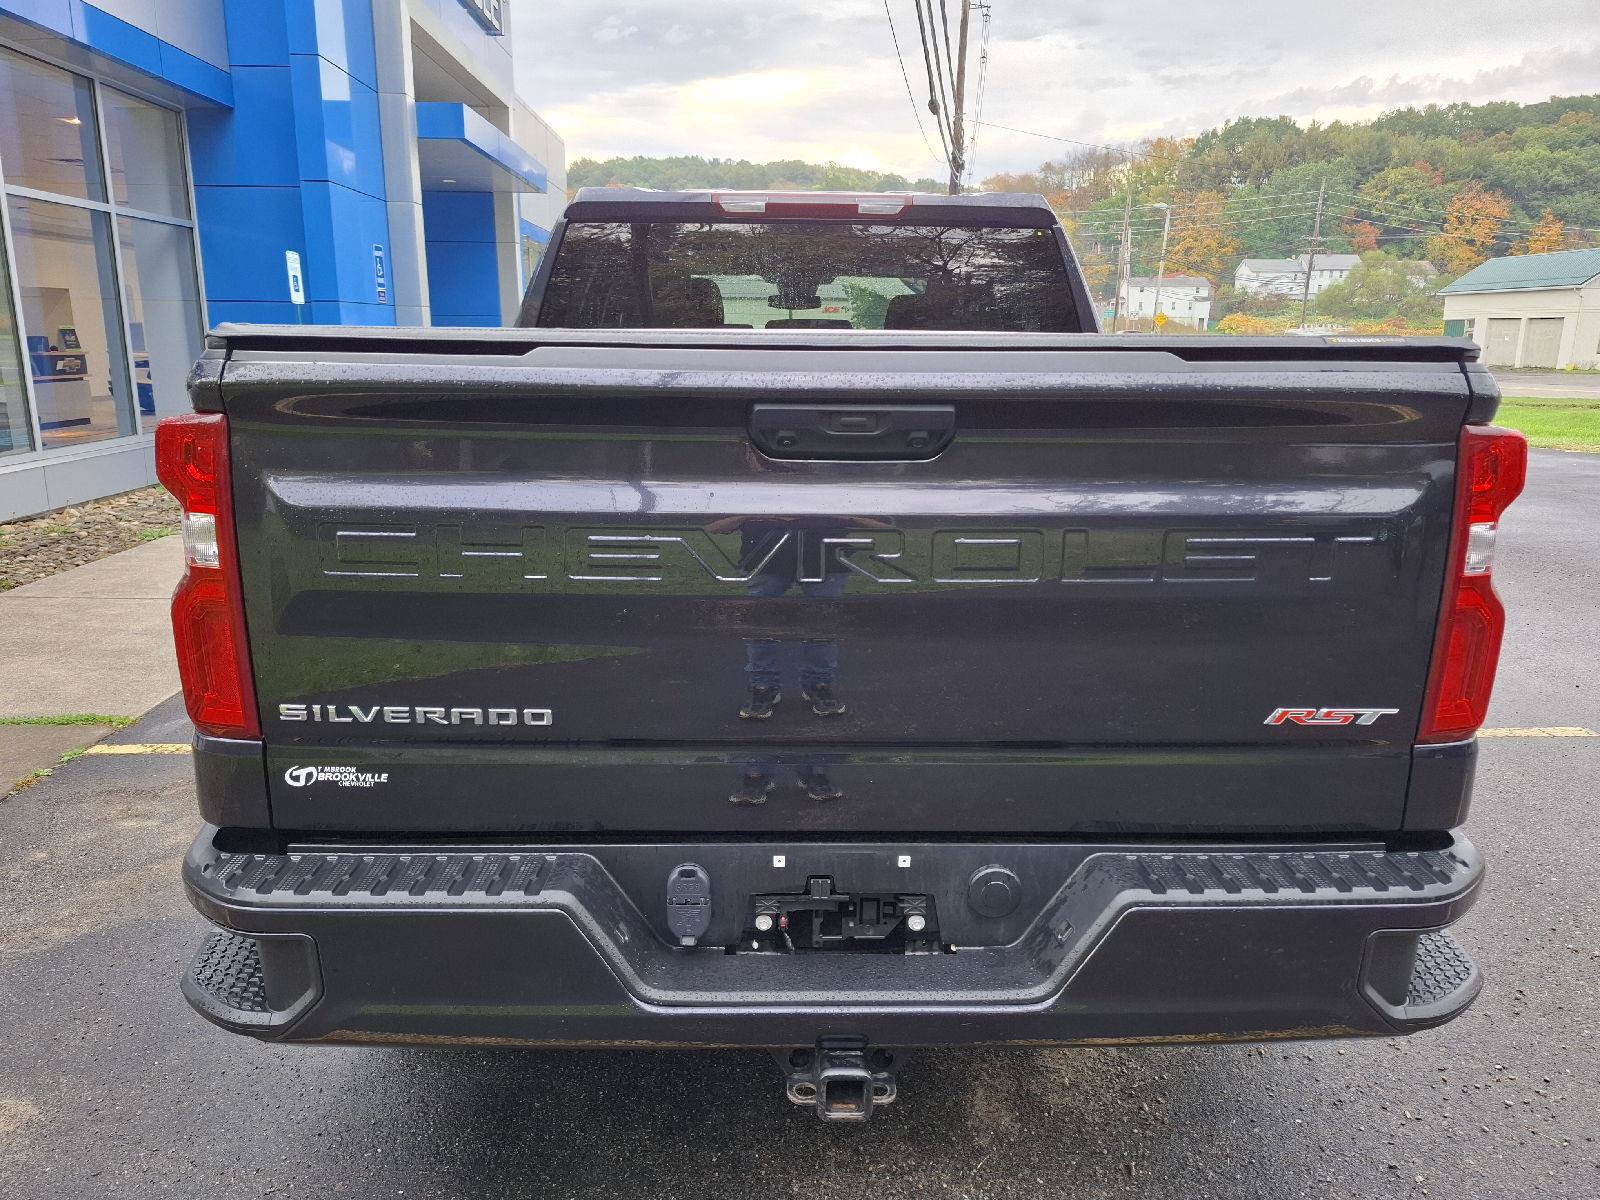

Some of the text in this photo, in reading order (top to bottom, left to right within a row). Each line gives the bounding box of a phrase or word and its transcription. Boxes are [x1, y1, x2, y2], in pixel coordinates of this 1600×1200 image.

[317, 522, 1379, 583] CHEVROLET
[279, 704, 552, 725] SILVERADO
[1263, 708, 1399, 725] RST
[317, 773, 389, 782] BROOKVILLE
